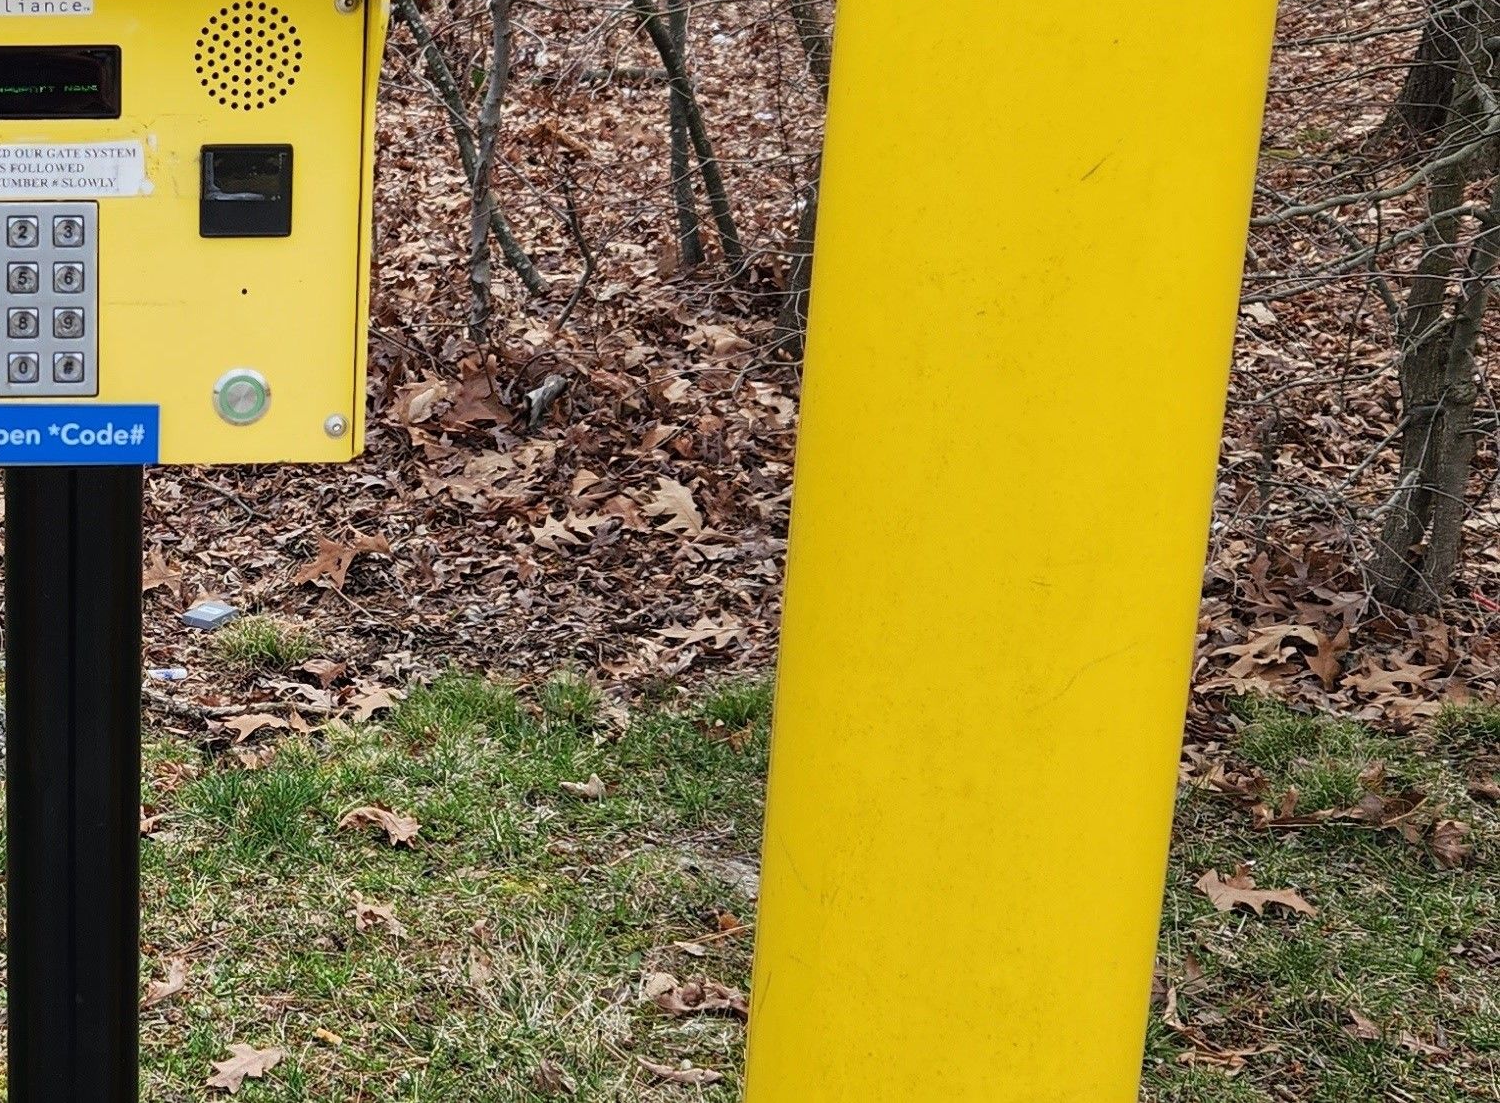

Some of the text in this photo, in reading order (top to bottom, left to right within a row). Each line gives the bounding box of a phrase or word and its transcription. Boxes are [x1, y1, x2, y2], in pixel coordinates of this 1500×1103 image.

[14, 148, 43, 159] OUR
[46, 148, 81, 158] GATE
[84, 147, 137, 158] SYSTEM
[10, 163, 85, 173] FOLLOWED
[60, 177, 117, 188] SLOWLY
[17, 225, 28, 239] 2
[63, 225, 73, 239] 3
[17, 271, 28, 286] 5
[63, 271, 74, 286] 6
[18, 316, 28, 331] 8
[63, 315, 73, 330] 9
[18, 361, 28, 375] 0
